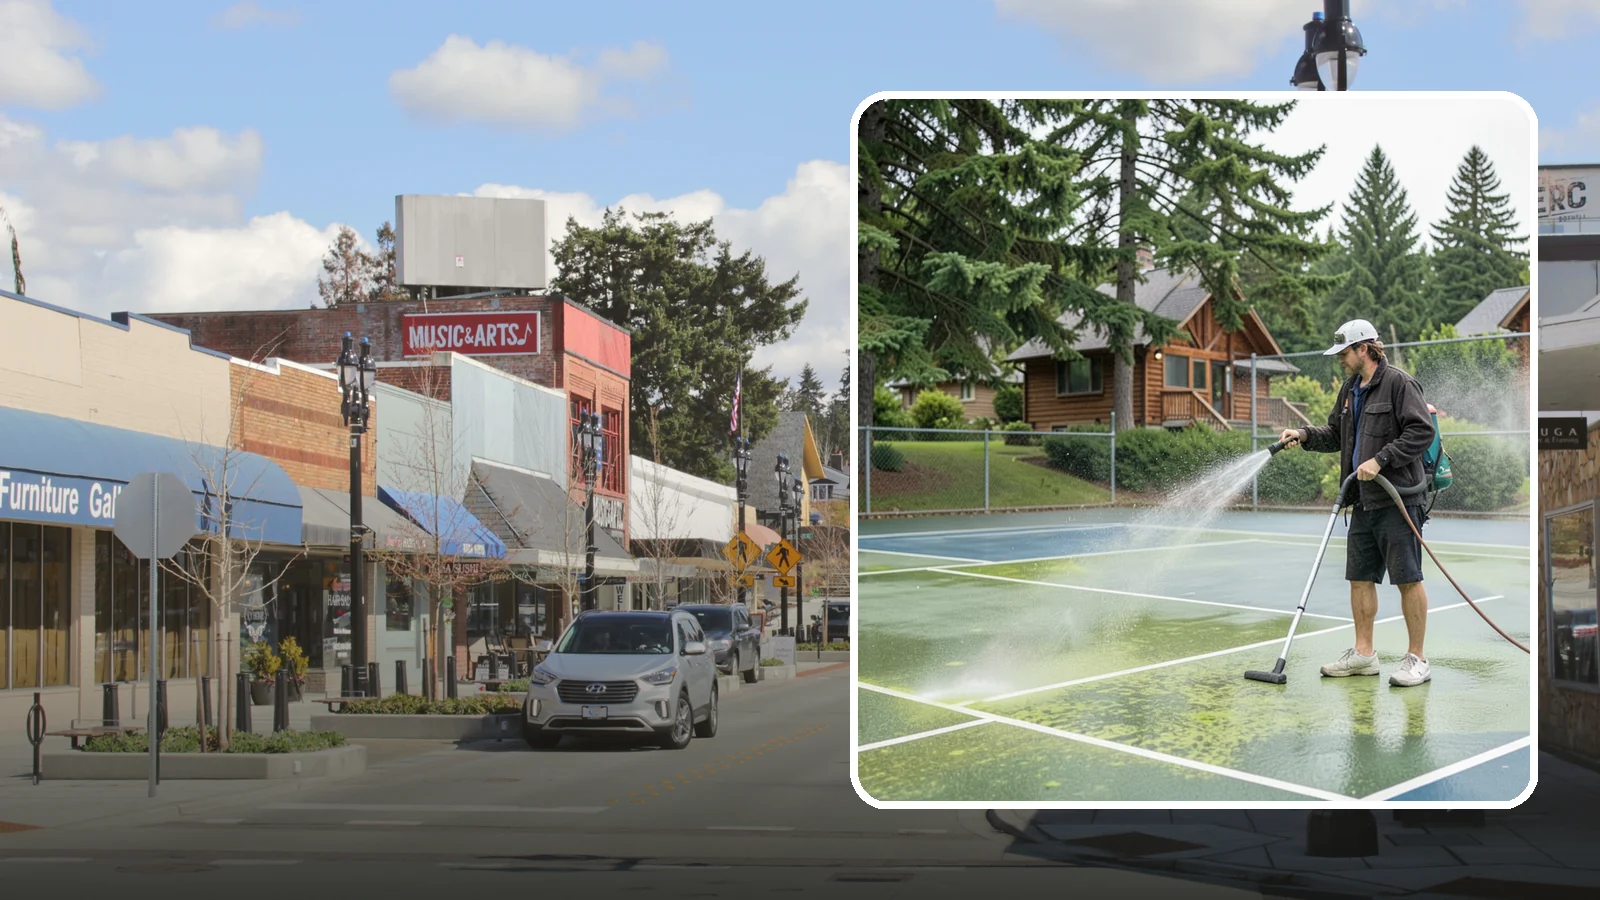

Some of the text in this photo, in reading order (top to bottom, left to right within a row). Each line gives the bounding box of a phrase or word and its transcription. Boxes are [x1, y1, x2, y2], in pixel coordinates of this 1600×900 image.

[1540, 427, 1578, 437] UGA
[0, 471, 79, 515] Furniture
[453, 563, 480, 574] SUSHI
